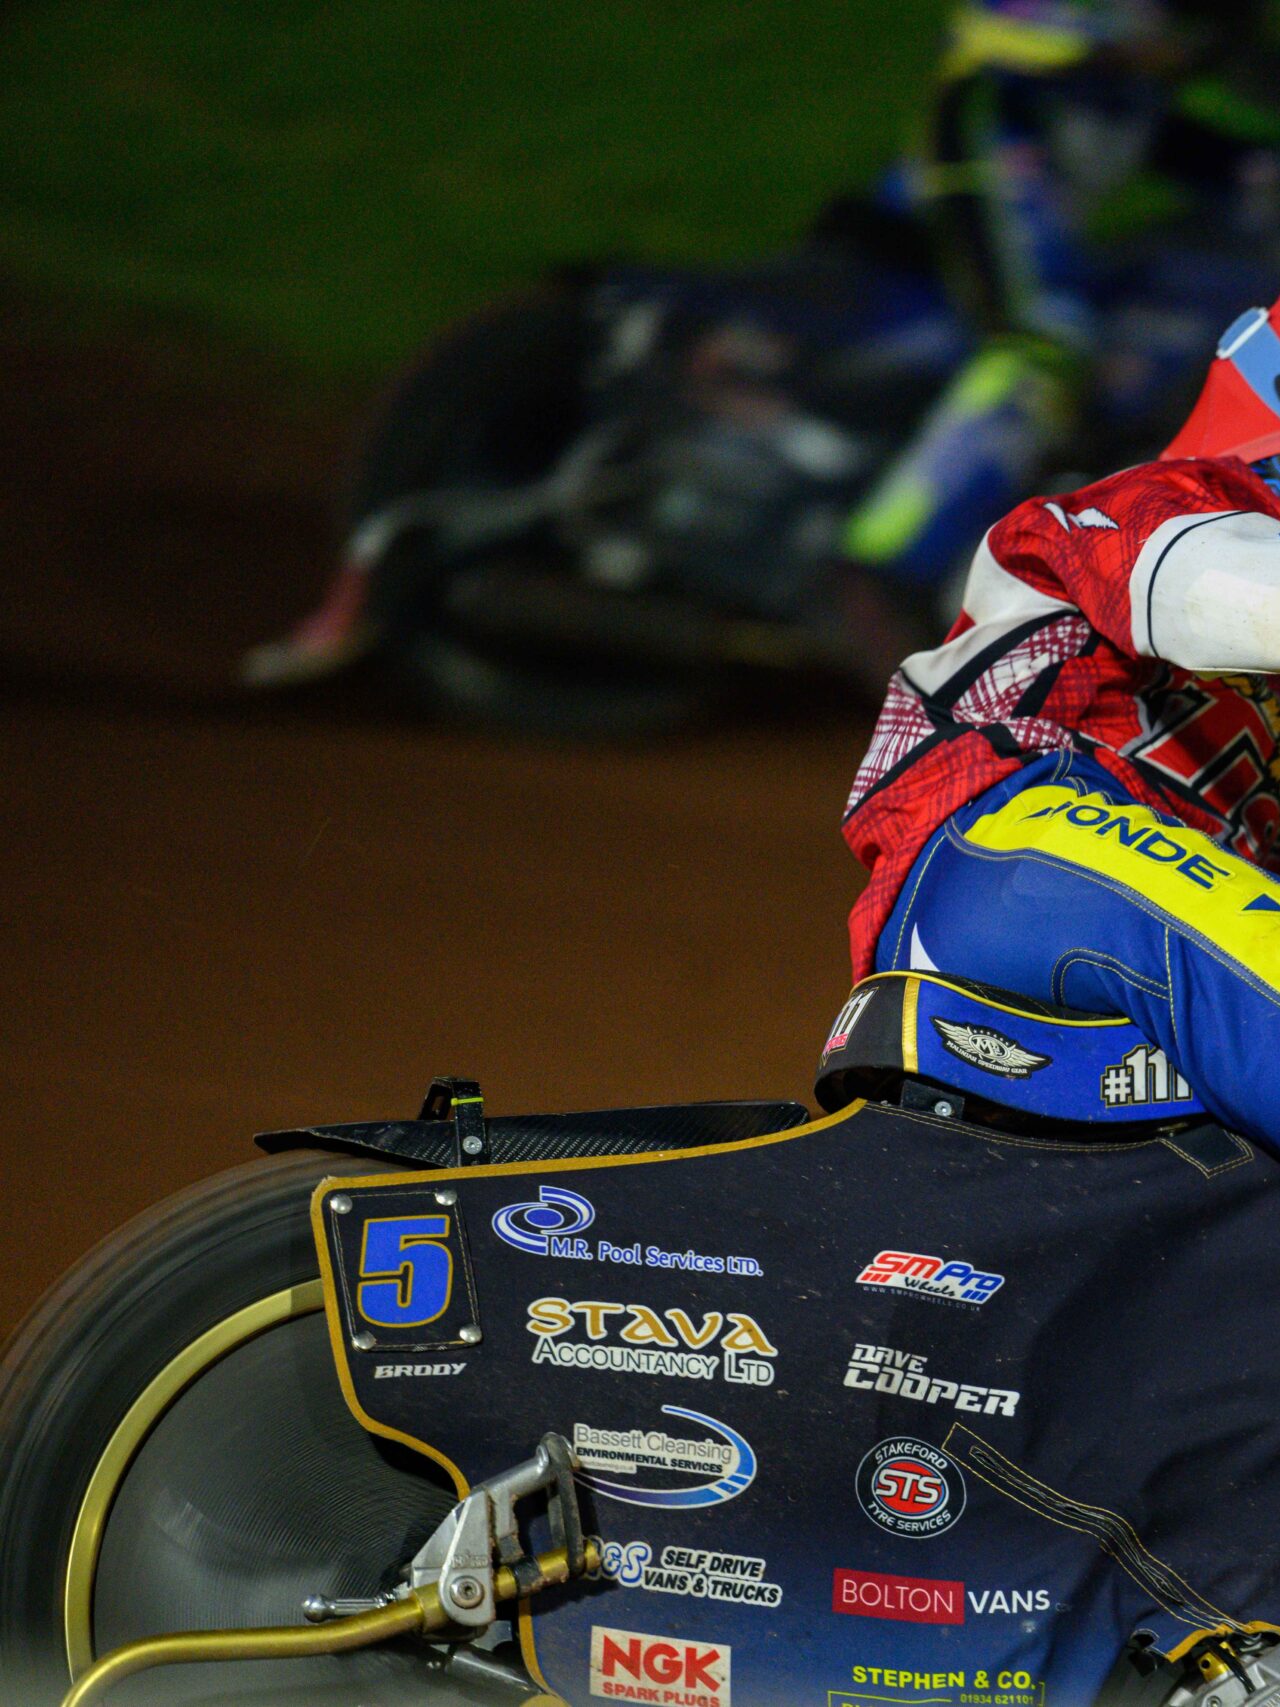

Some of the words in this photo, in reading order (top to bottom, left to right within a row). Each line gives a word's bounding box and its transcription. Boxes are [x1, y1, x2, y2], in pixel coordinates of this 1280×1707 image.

[1066, 802, 1230, 891] ONDE
[978, 1060, 1010, 1073] SPEEDWAY
[357, 1214, 453, 1328] 5
[551, 1236, 593, 1260] M.R.
[599, 1242, 641, 1265] Pool
[645, 1247, 723, 1273] Services
[727, 1256, 764, 1277] LTD.
[905, 1277, 955, 1297] Wheels
[374, 1362, 467, 1379] BRODY
[851, 1343, 928, 1373] DAVE
[843, 1360, 1021, 1417] COOPER
[575, 1426, 642, 1450] Bassett
[647, 1434, 733, 1464] Cleansing
[576, 1447, 668, 1467] ENVIRONMENTAL
[670, 1457, 723, 1474] SERVICES
[874, 1442, 948, 1471] STAKEFORD
[875, 1468, 942, 1504] STS
[868, 1501, 894, 1526] TYRE
[896, 1509, 951, 1532] SERVICES
[663, 1549, 706, 1570] SELF
[710, 1556, 762, 1578] DRIVE
[644, 1570, 688, 1592] VANS
[693, 1577, 705, 1593] &
[711, 1580, 779, 1604] TRUCKS
[842, 1579, 953, 1614] BOLTON
[968, 1589, 1050, 1614] VANS
[602, 1634, 721, 1692] NGK
[852, 1665, 965, 1690] STEPHEN
[973, 1670, 990, 1689] &
[997, 1671, 1036, 1690] CO.
[602, 1682, 659, 1703] SPARK
[664, 1688, 721, 1707] PLUGS
